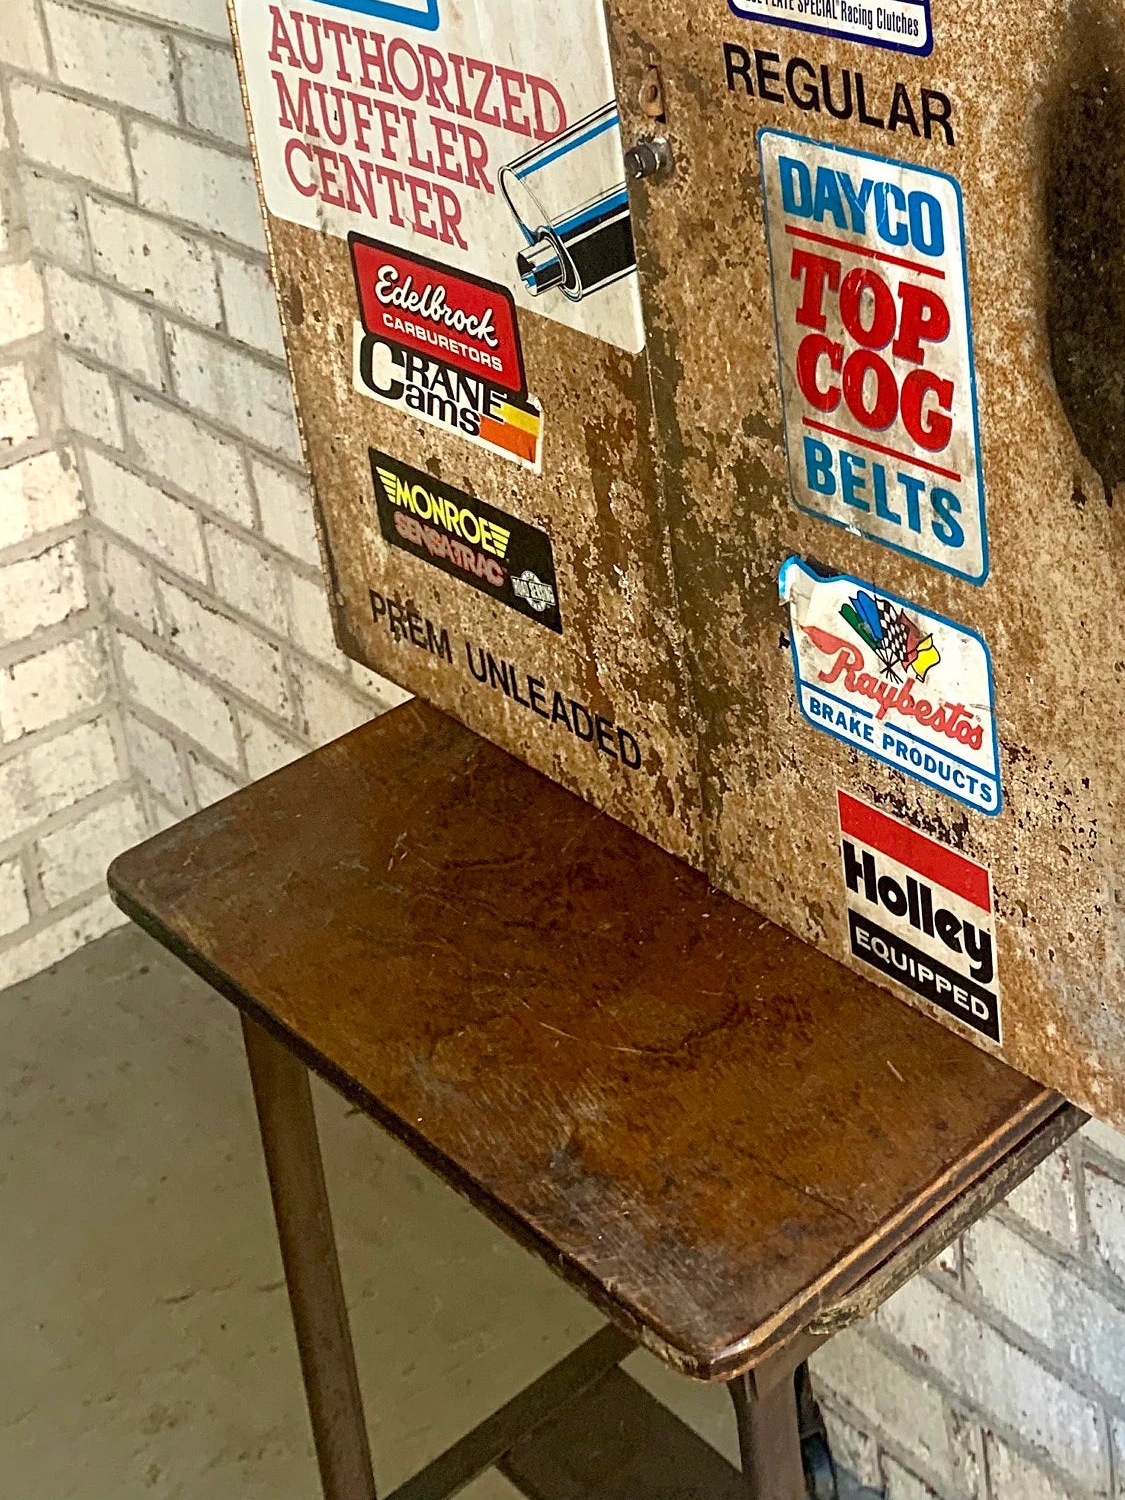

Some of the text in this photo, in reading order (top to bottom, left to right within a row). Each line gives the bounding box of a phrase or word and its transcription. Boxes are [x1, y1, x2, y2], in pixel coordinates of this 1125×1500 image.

[268, 5, 568, 142] AUTHORIZED
[841, 4, 873, 30] Racing
[877, 7, 919, 36] Clutches
[271, 70, 494, 194] MUFFLER
[723, 42, 955, 146] REGULAR
[285, 139, 468, 251] CENTER
[778, 155, 945, 258] DAYCO
[375, 265, 498, 347] Edelbrock
[382, 312, 503, 372] CARBURETORS
[790, 248, 951, 365] TOP
[360, 335, 506, 423] CRANE
[796, 333, 954, 453] COG
[396, 477, 498, 556] MONROE
[803, 435, 965, 548] BELTS
[369, 589, 642, 771] PREM UNLEADED
[801, 626, 985, 751] Raybestos
[809, 696, 993, 803] BRAKE PRODUCTS
[842, 839, 994, 985] Holley
[855, 925, 991, 1021] EQUIPPED
